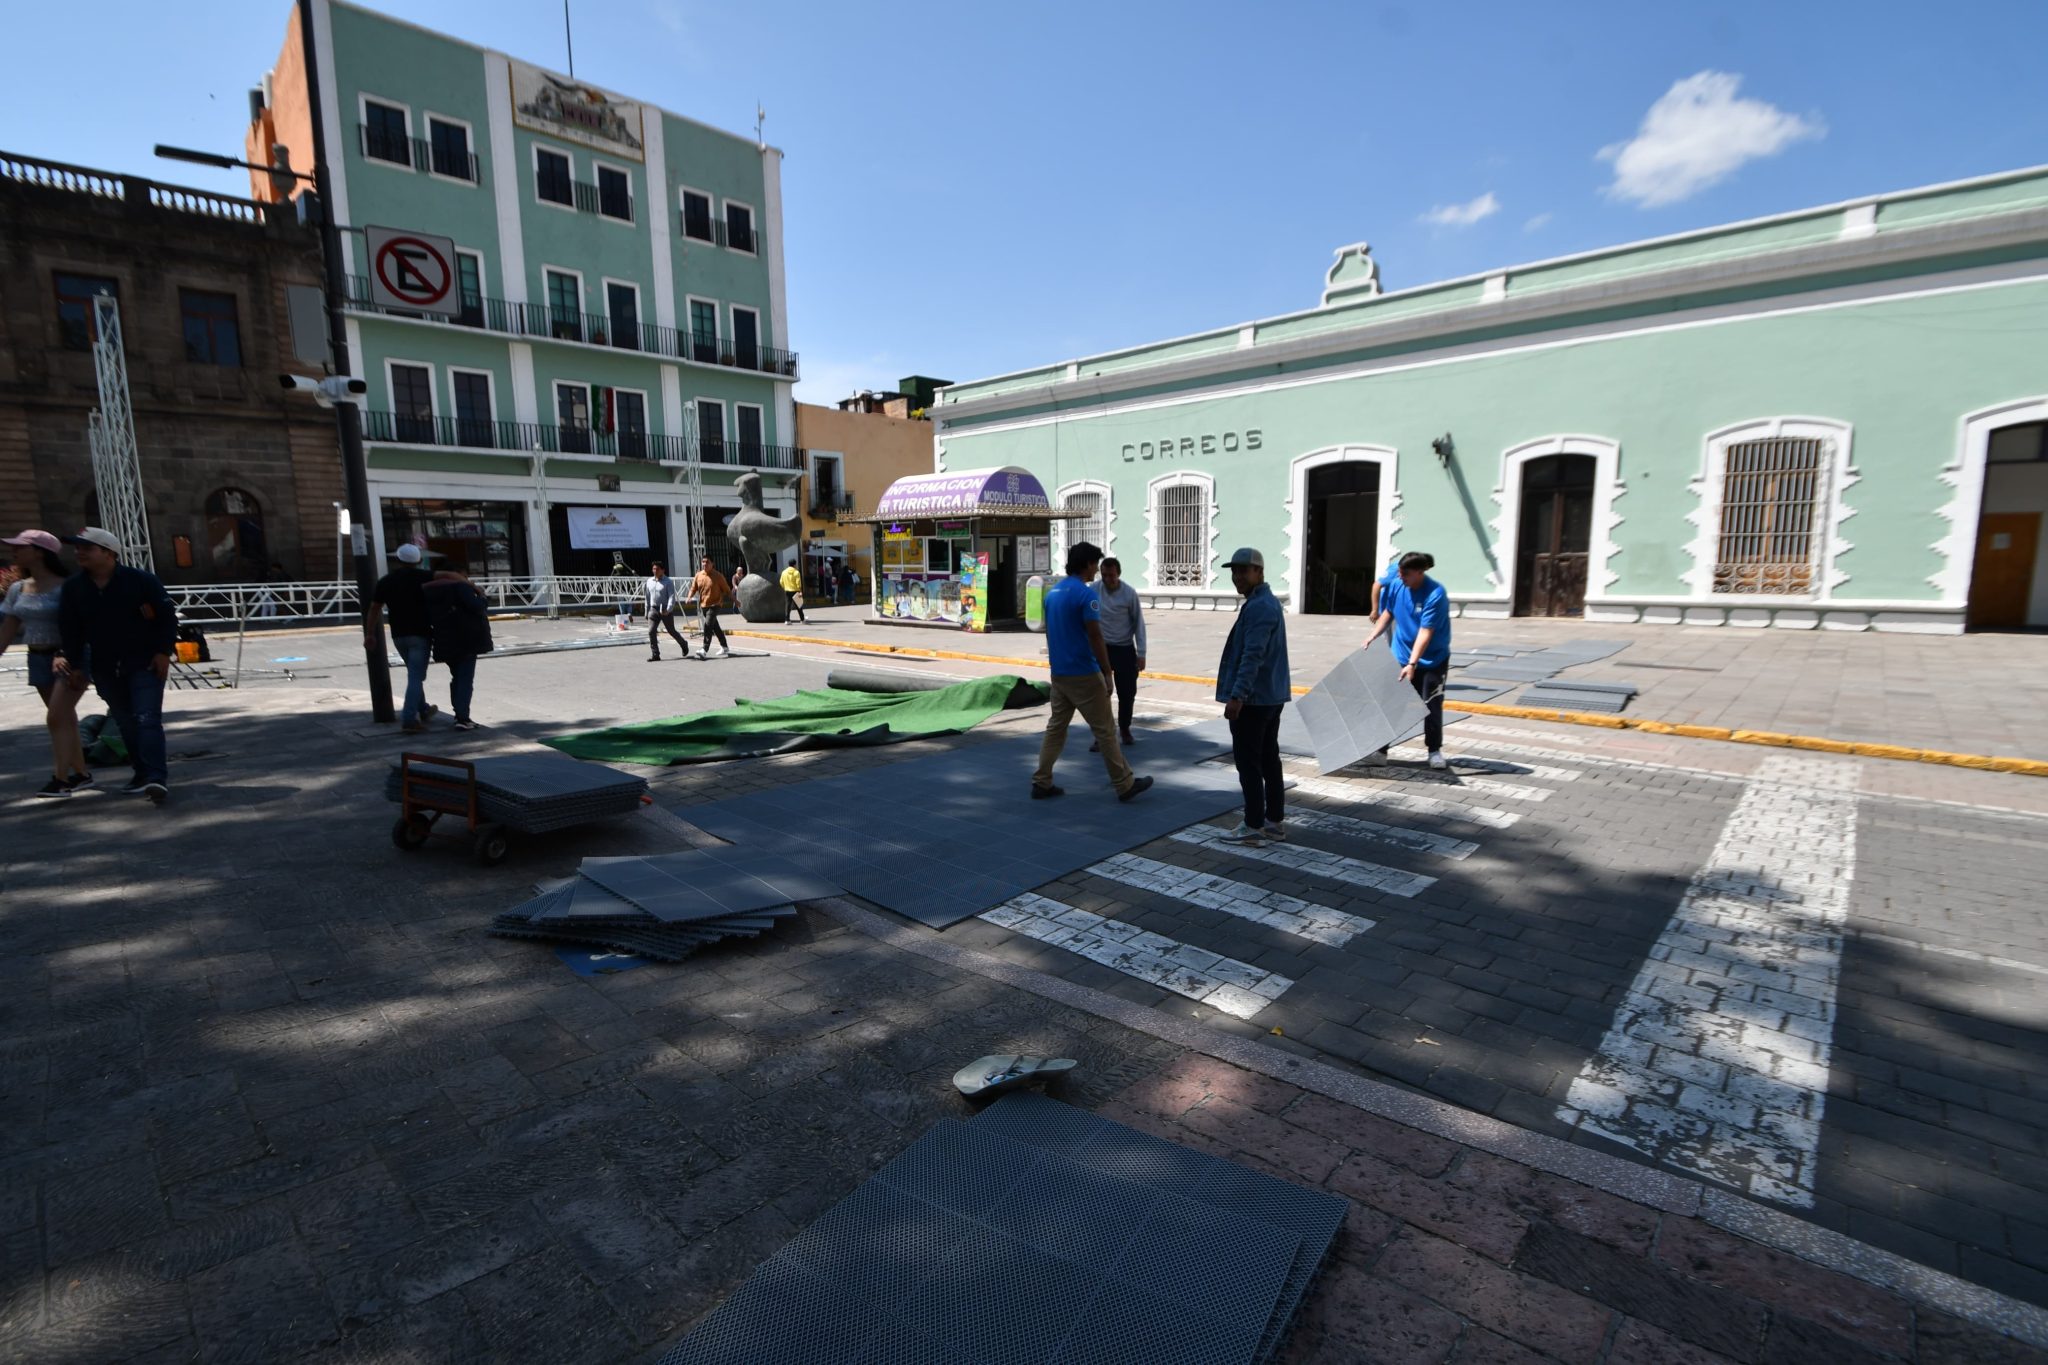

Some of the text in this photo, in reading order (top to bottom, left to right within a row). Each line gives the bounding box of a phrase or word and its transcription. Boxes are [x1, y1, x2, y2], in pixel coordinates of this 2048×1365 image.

[1122, 429, 1262, 462] CORREOS
[887, 478, 983, 495] INFORMACION
[892, 495, 961, 510] TURISTICA
[1014, 492, 1046, 505] TURISTICO
